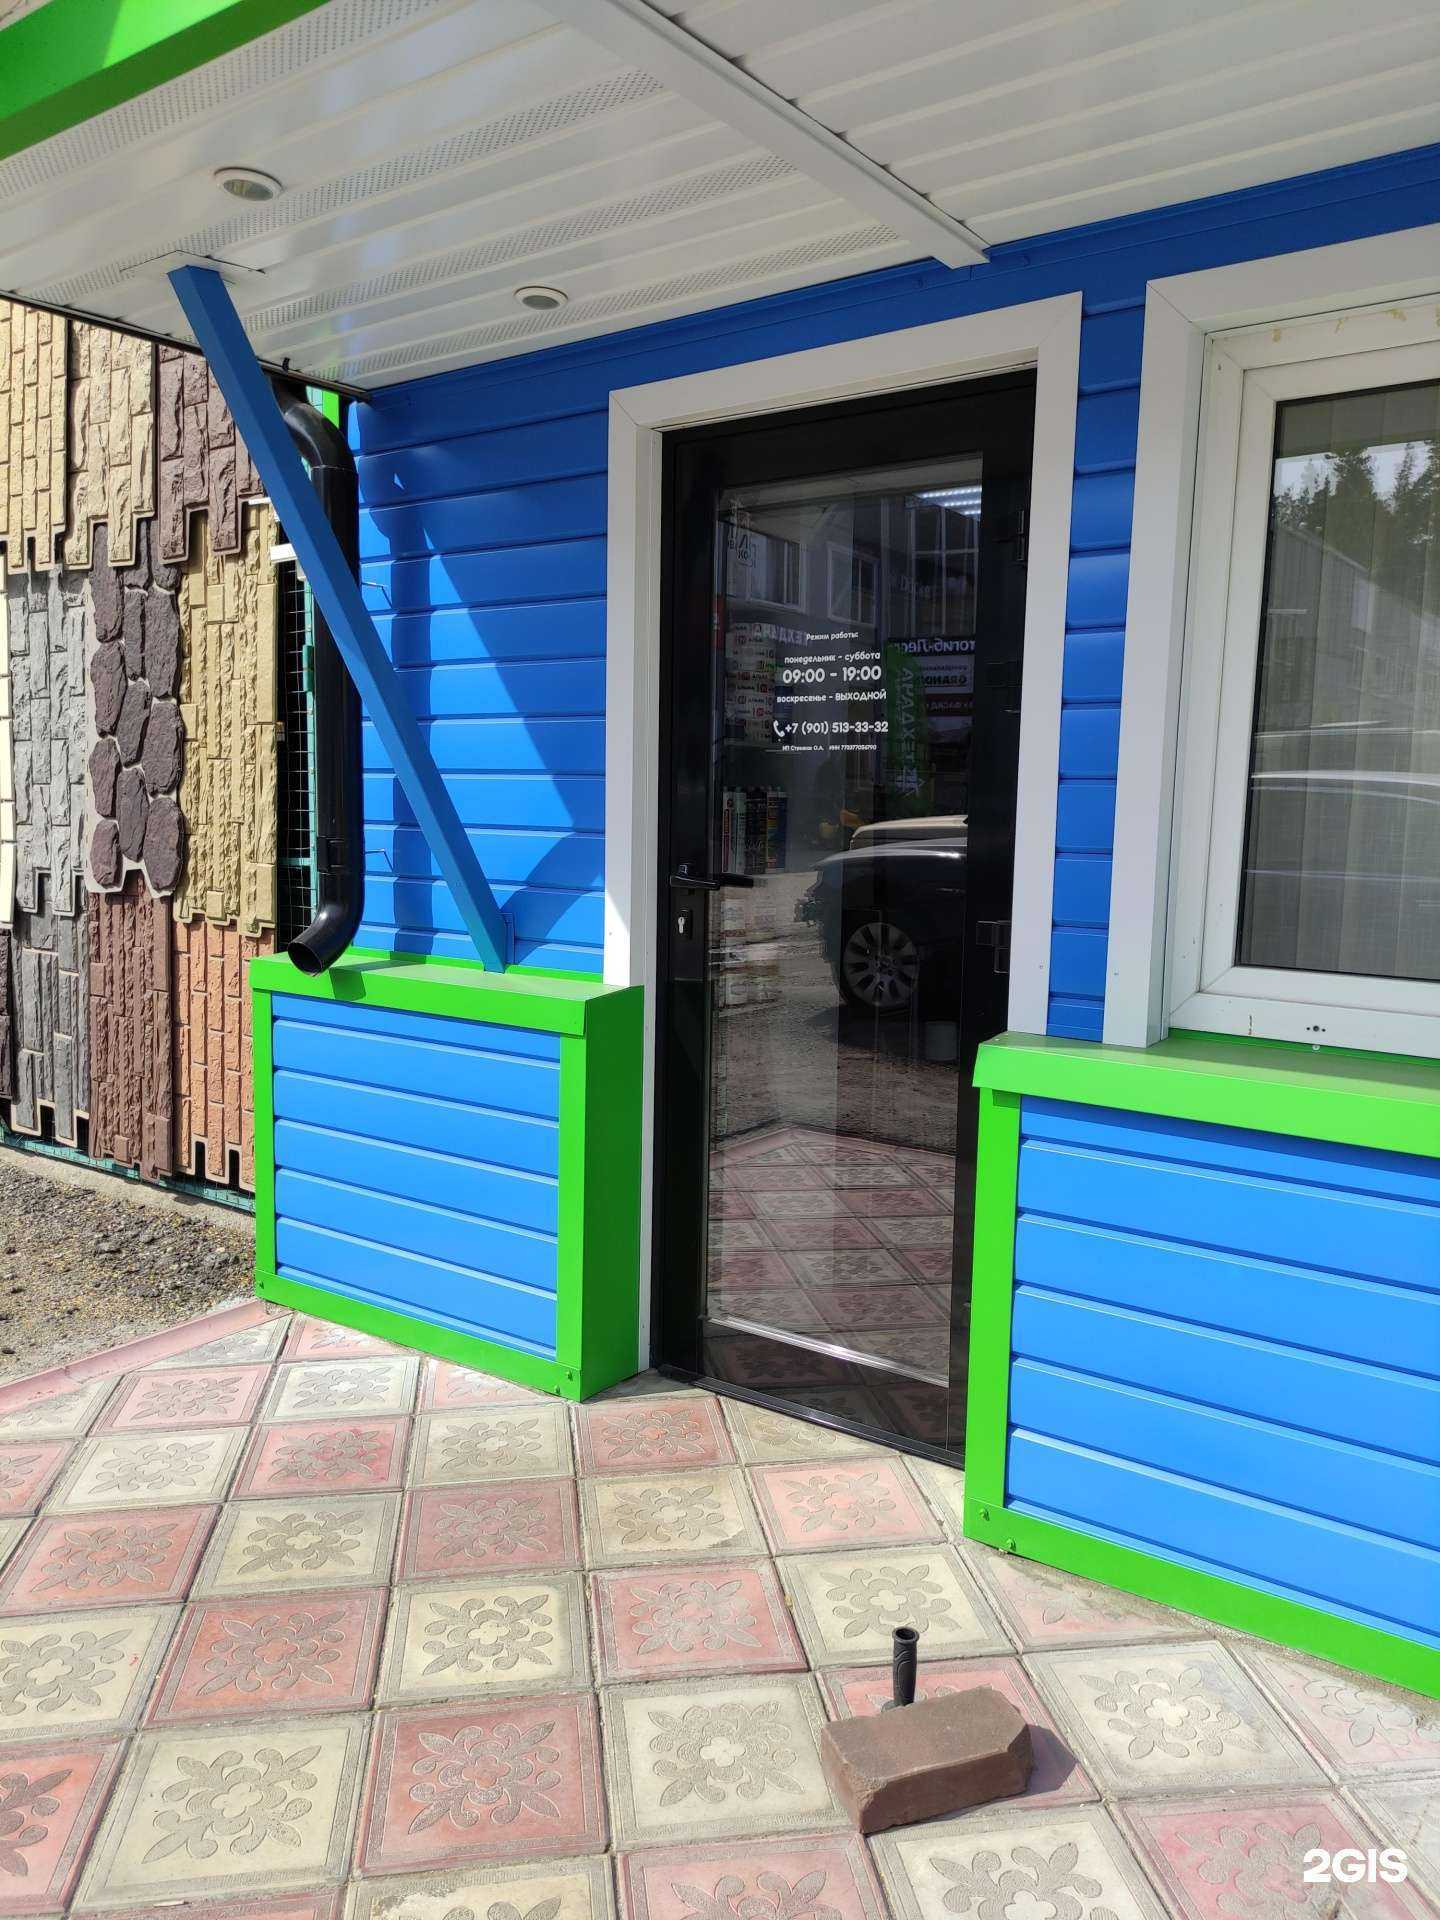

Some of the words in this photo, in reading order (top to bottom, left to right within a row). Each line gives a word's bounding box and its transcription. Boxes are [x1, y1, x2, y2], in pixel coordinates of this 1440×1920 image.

[806, 633, 830, 641] Режим
[784, 654, 836, 665] понедельник
[844, 651, 881, 662] суббота
[782, 667, 826, 684] 09:00
[842, 665, 882, 681] 19:00
[776, 694, 827, 704] воскресенье
[835, 688, 887, 701] ВЫХОДНОЙ
[785, 722, 799, 734] +7
[801, 721, 829, 735] (901)
[831, 721, 889, 733] 513-33-32
